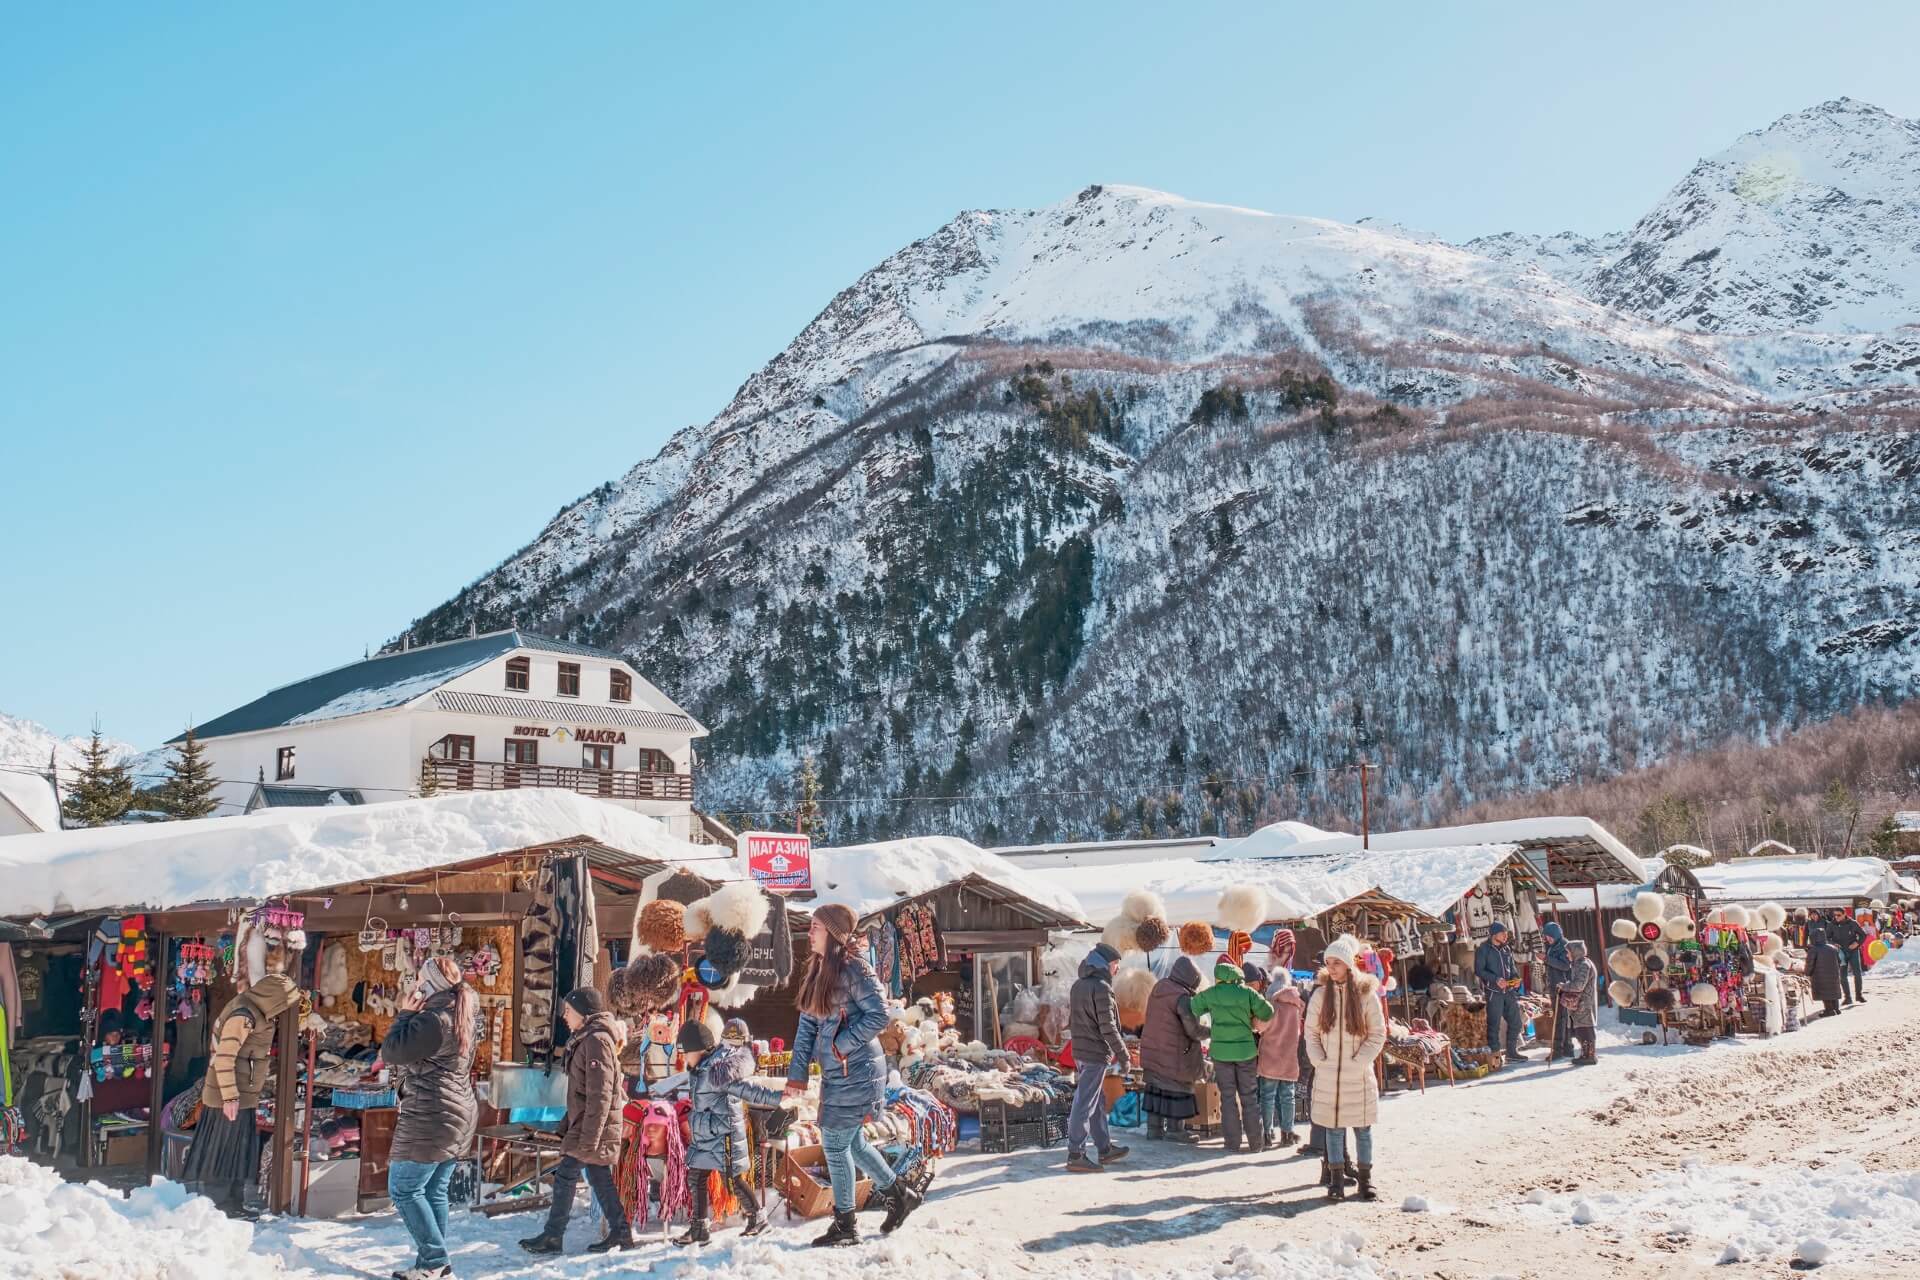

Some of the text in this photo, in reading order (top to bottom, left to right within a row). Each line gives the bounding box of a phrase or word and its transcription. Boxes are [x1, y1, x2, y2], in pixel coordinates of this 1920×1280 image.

[513, 725, 627, 745] HOTEL NAKRA
[749, 840, 809, 859] МАГАЗИН
[775, 857, 784, 865] 15
